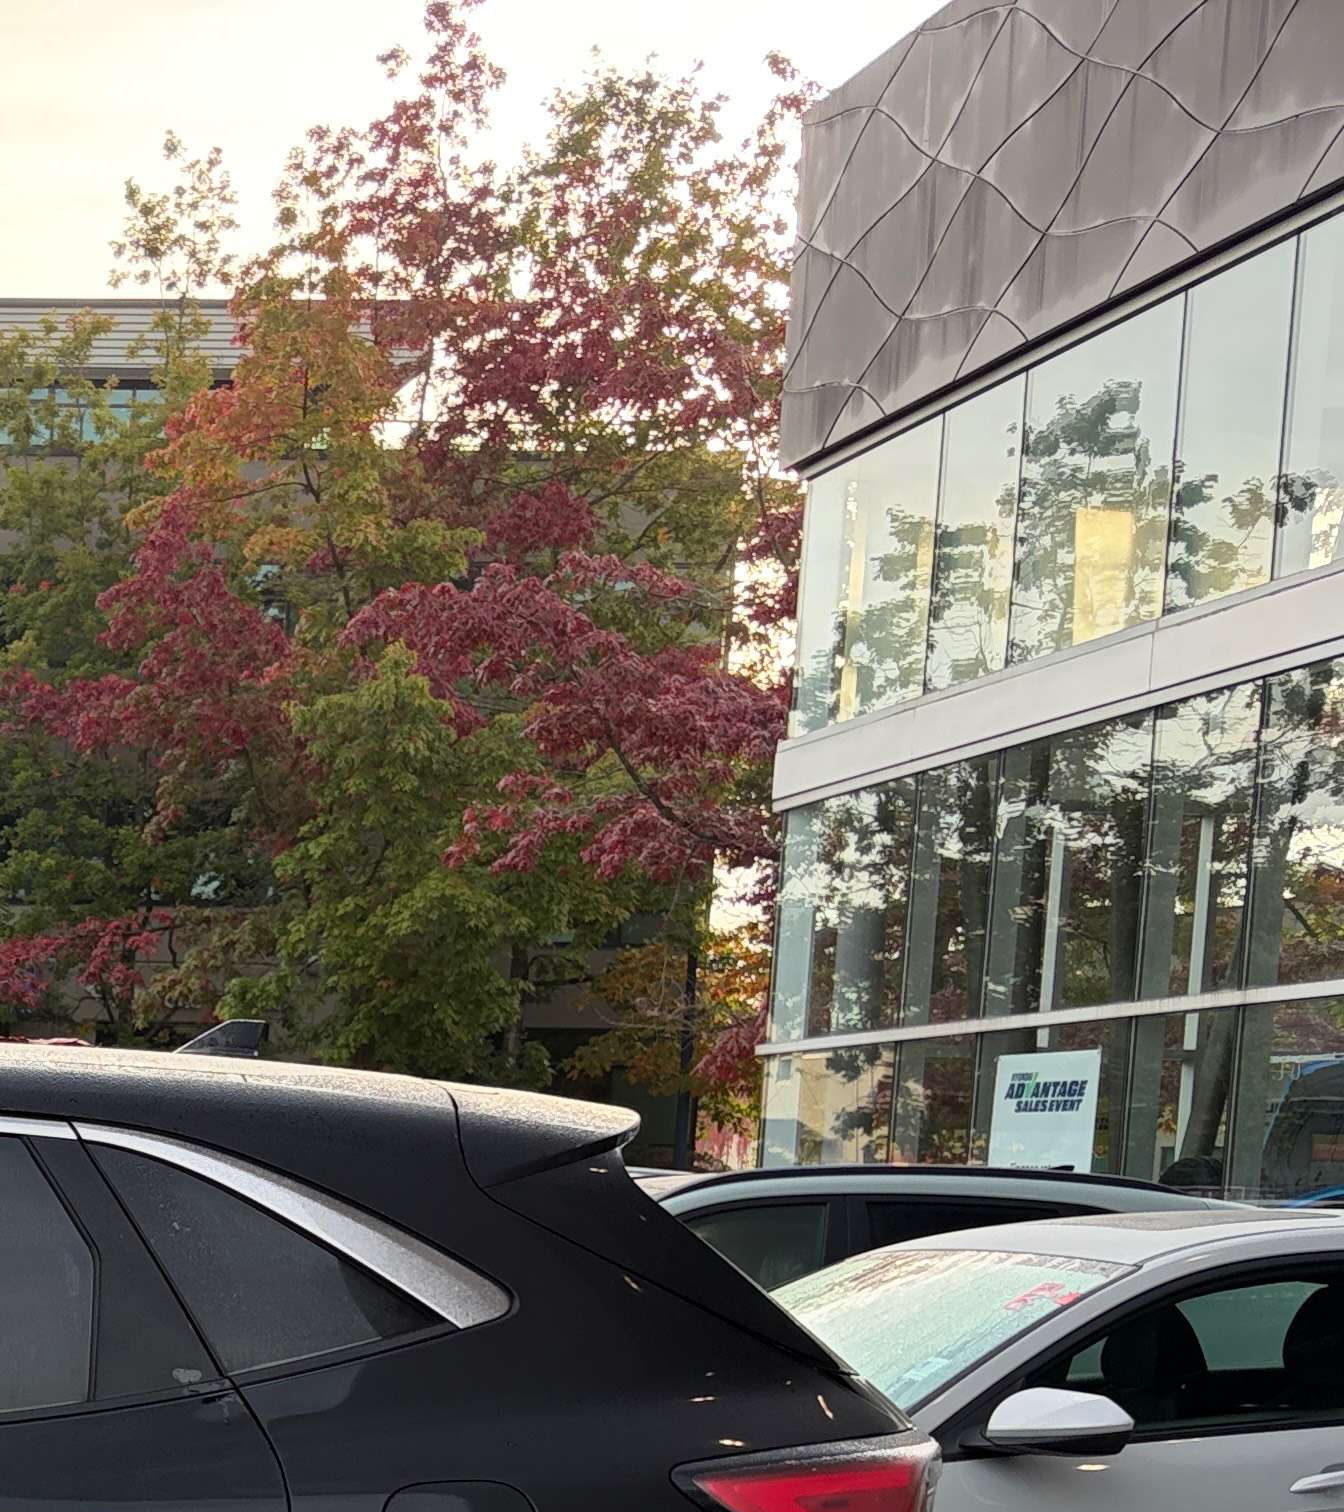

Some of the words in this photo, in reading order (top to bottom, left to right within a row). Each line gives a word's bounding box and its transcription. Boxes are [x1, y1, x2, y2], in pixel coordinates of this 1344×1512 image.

[1004, 1077, 1089, 1100] ADVANTAGE
[1014, 1100, 1048, 1113] SALES
[1048, 1098, 1083, 1112] EVENT
